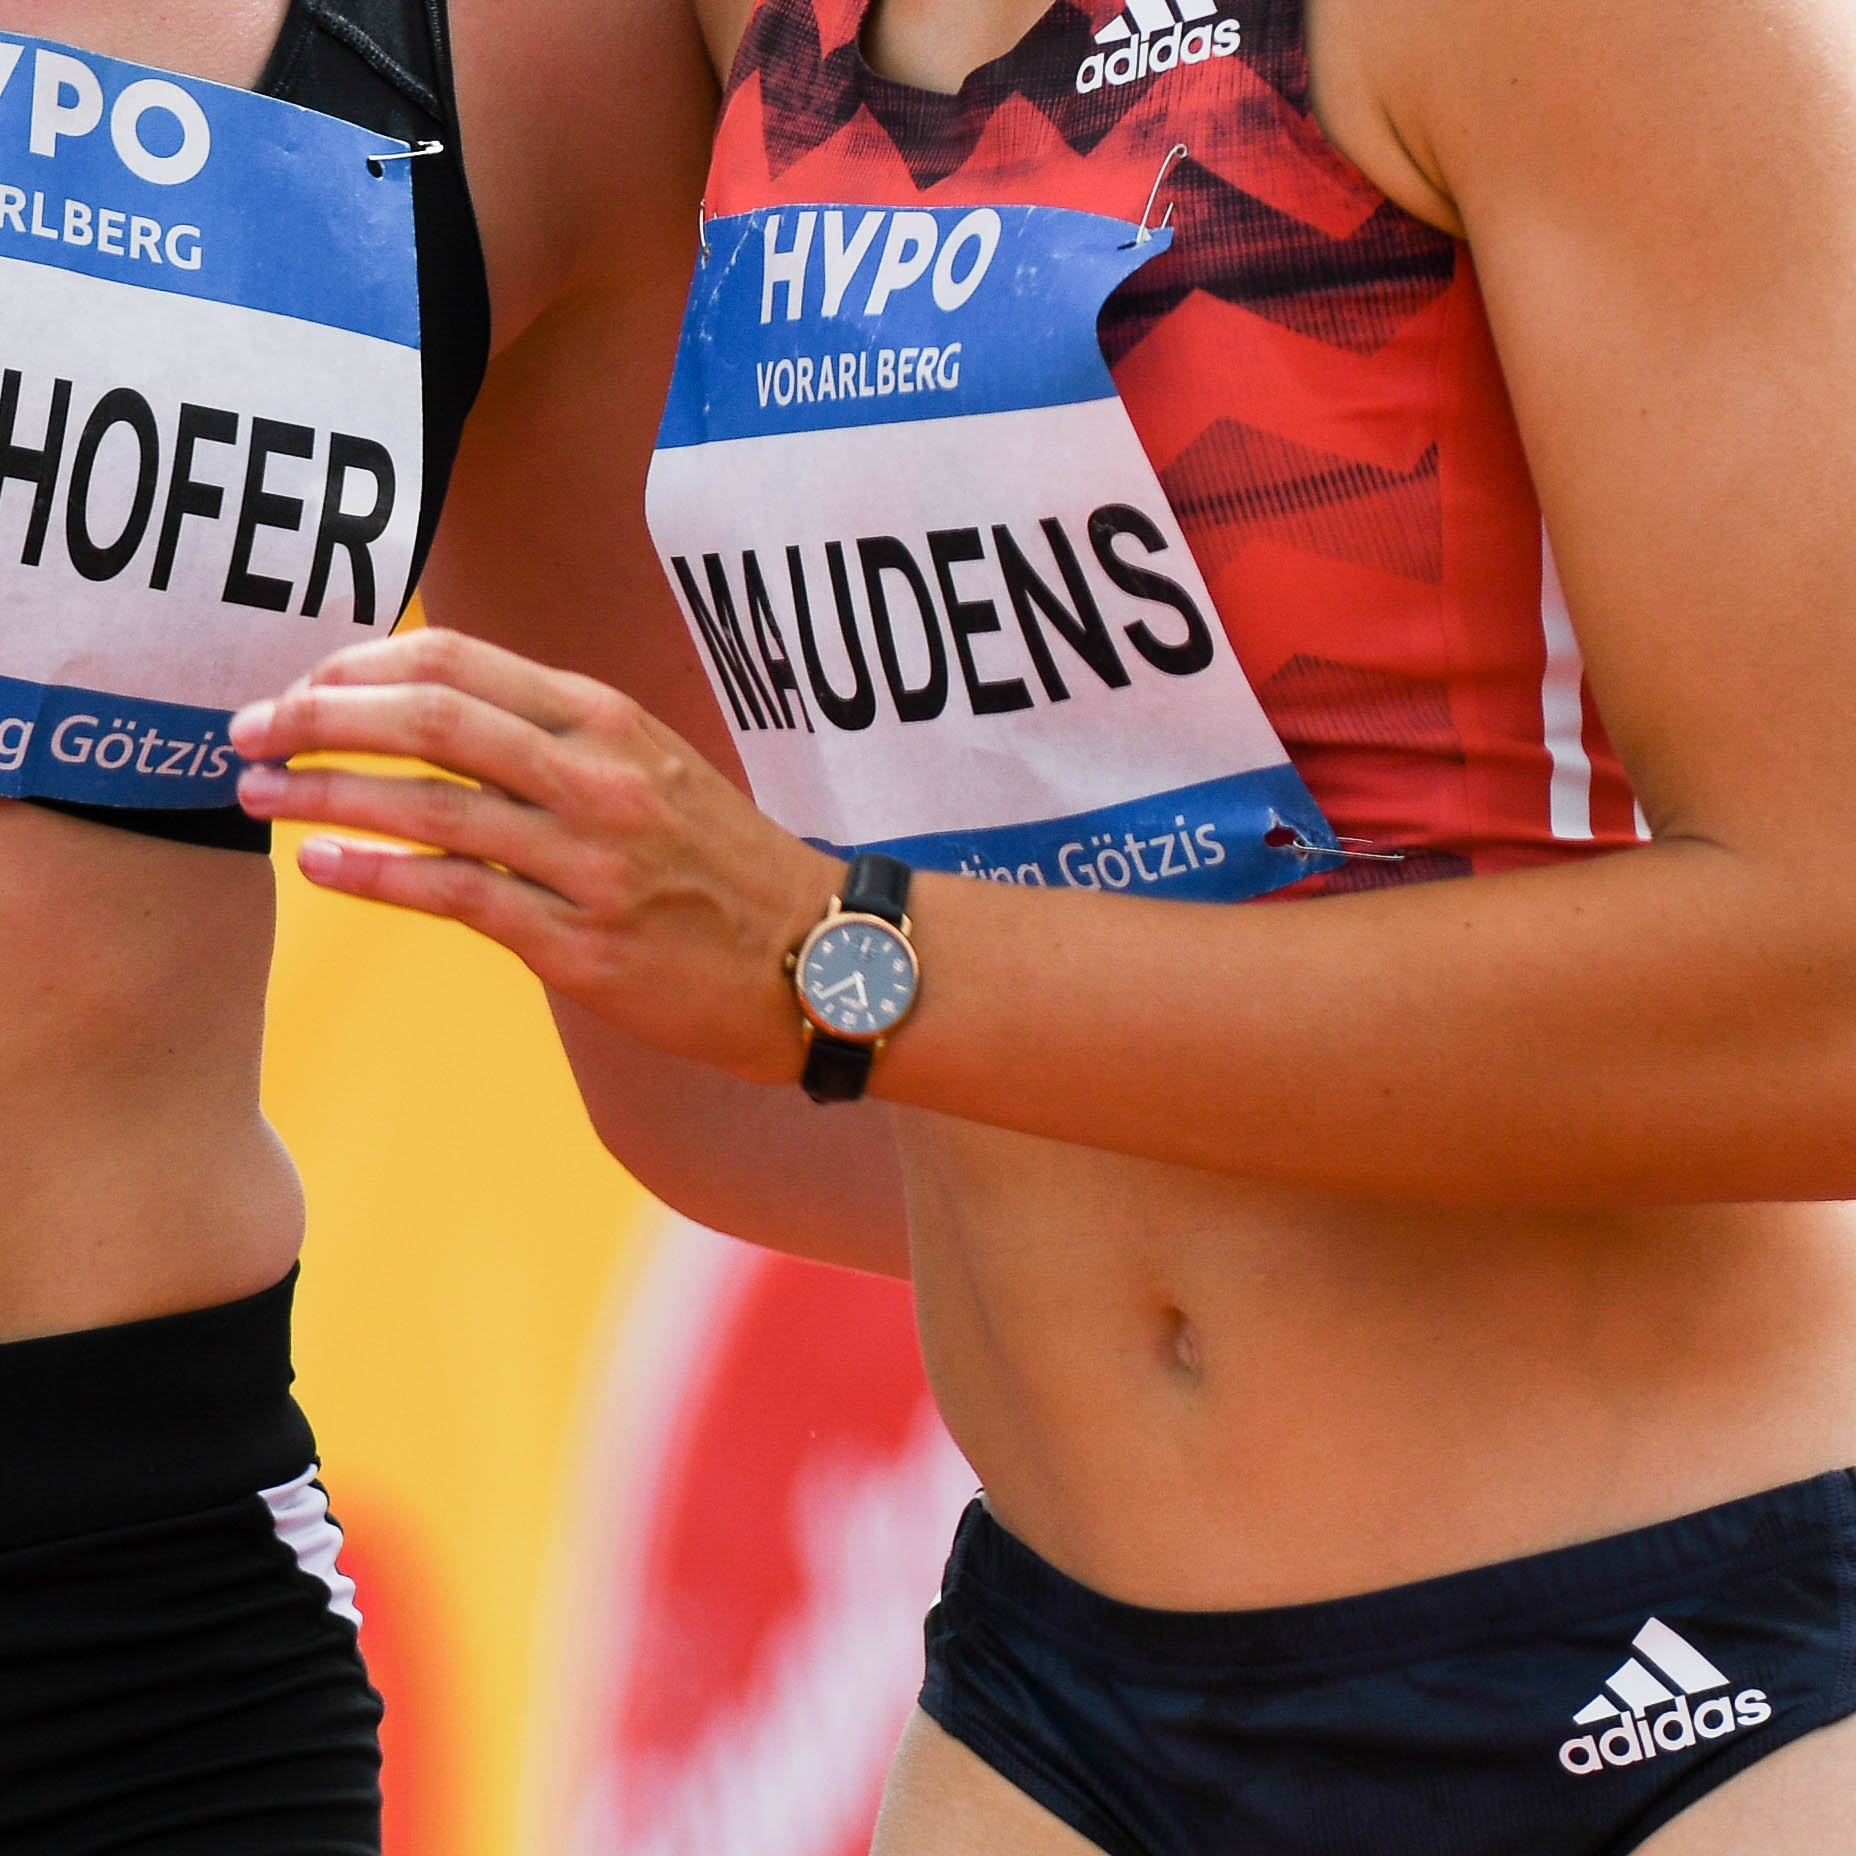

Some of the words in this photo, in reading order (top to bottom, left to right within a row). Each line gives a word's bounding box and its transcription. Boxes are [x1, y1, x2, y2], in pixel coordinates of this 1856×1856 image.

[1075, 16, 1241, 94] adidas
[760, 207, 1001, 326] HYPO
[756, 342, 962, 407] VORARLBERG
[671, 502, 1215, 734] MAUDENS
[50, 712, 236, 783] Götzis
[1057, 814, 1226, 891] Götzis
[1558, 1688, 1772, 1775] adidas
